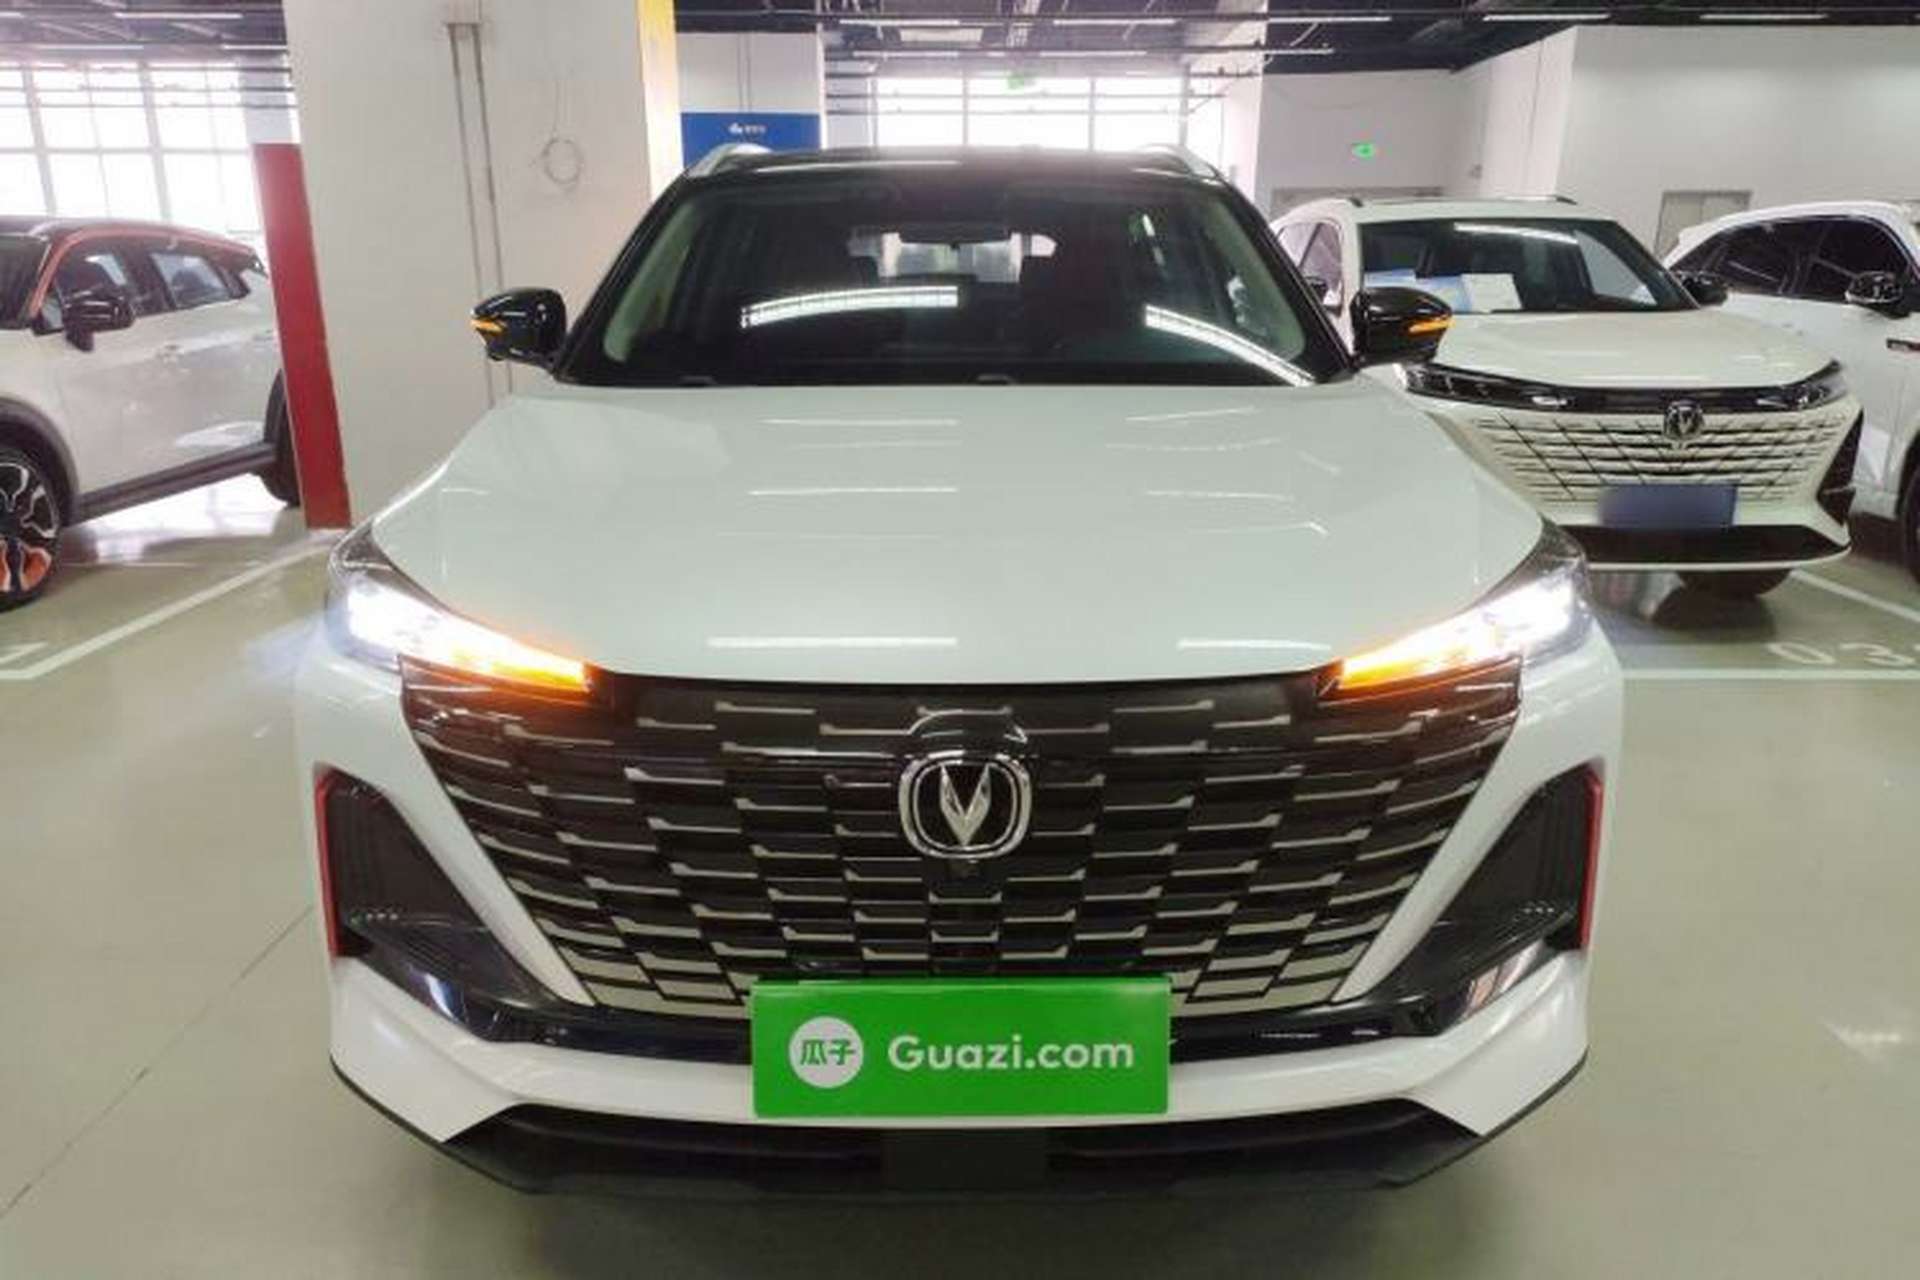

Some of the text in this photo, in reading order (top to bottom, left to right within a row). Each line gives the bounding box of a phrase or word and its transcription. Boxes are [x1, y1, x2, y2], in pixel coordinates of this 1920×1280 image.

[1766, 642, 1920, 666] 03
[800, 1038, 857, 1067] 瓜子
[887, 1034, 1134, 1071] Guazi.com
